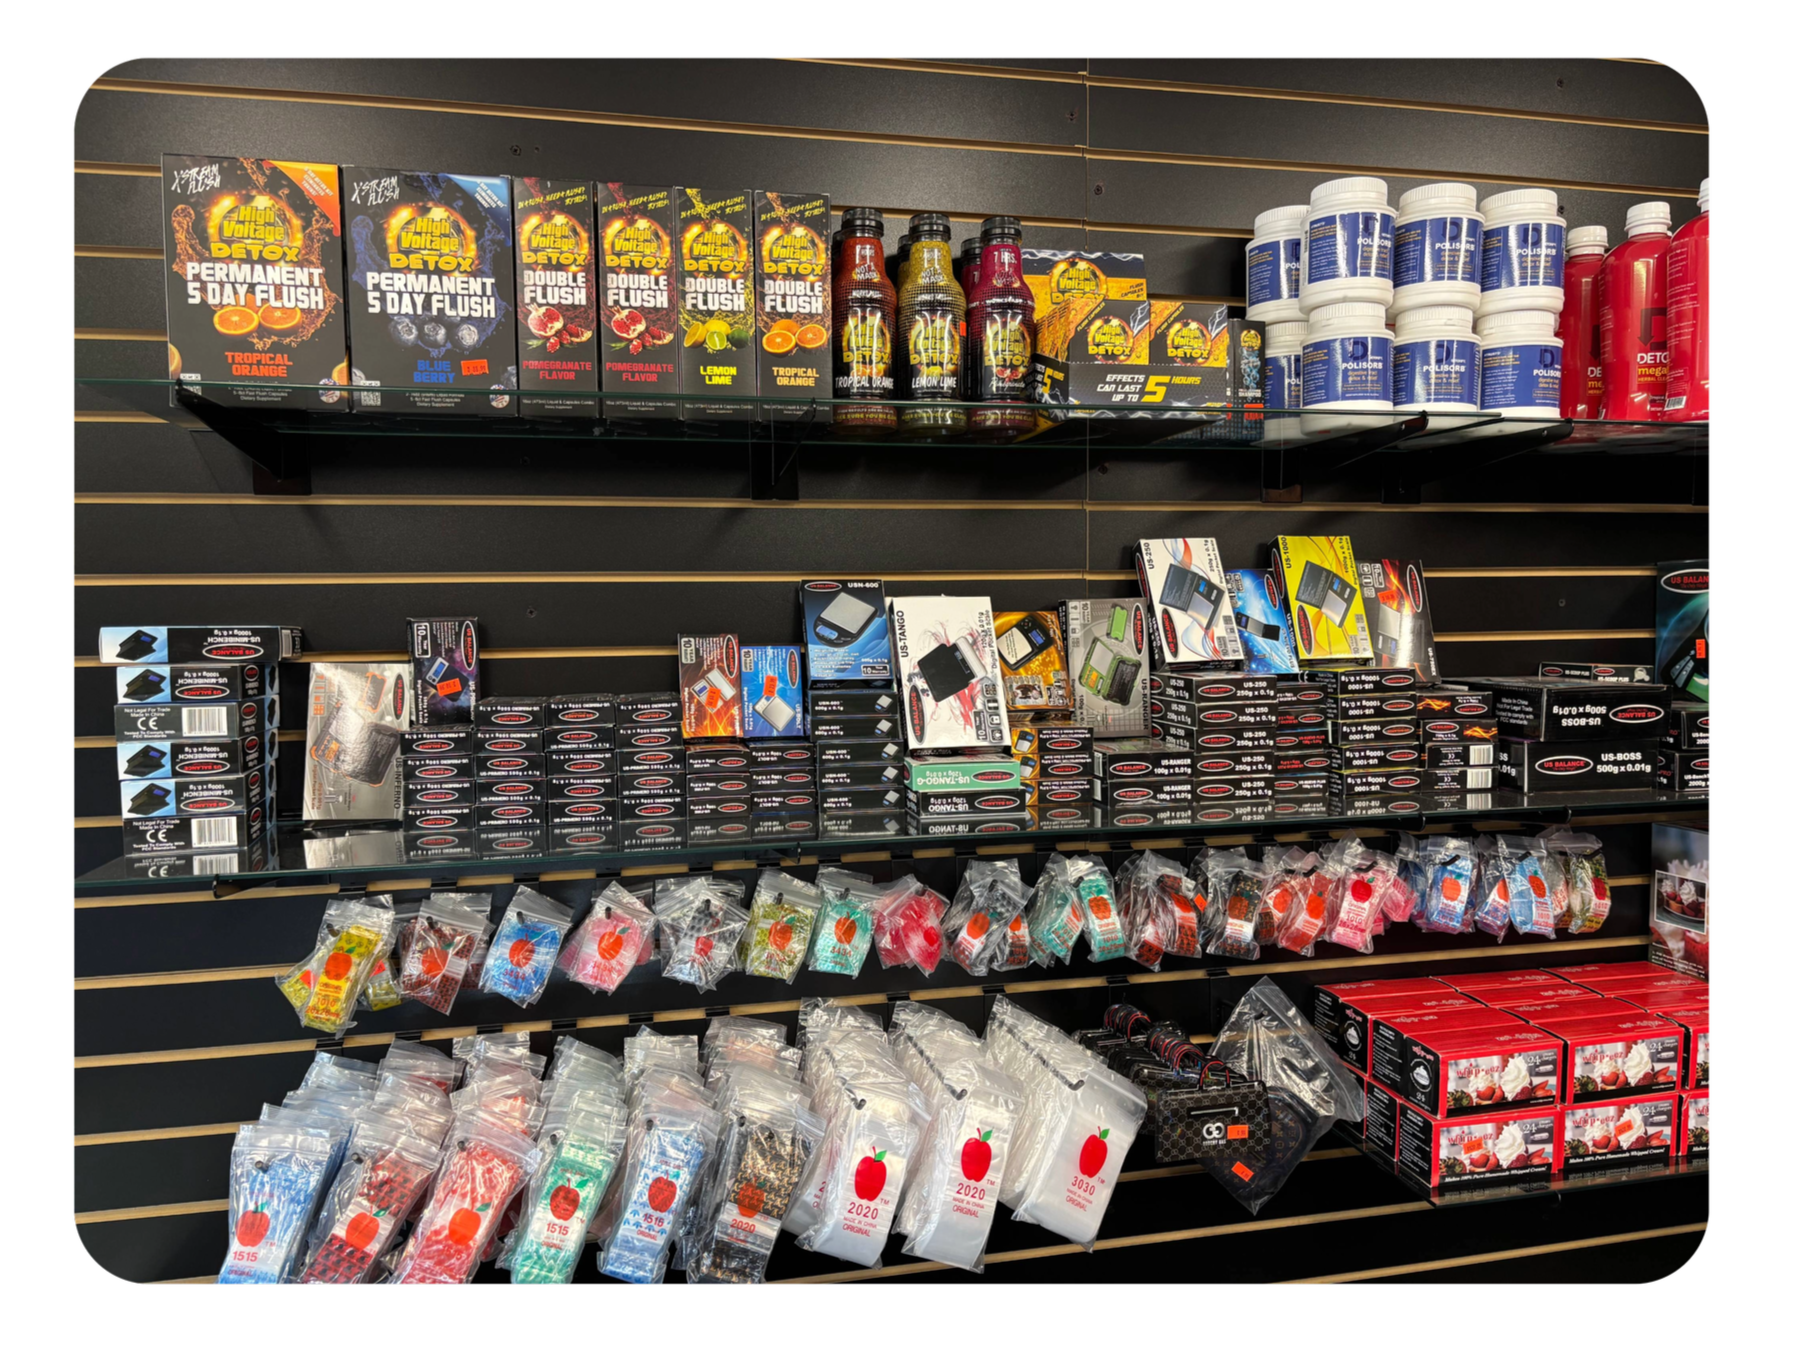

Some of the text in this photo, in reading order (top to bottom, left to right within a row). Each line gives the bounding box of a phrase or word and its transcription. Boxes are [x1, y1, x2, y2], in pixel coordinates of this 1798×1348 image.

[238, 206, 275, 222] High
[223, 220, 285, 241] Voltage
[415, 217, 450, 234] High
[542, 222, 569, 238] High
[626, 227, 651, 241] High
[705, 231, 729, 244] High
[401, 232, 459, 252] Voltage
[531, 234, 576, 249] Voltage
[615, 238, 658, 253] Voltage
[783, 234, 807, 248] High
[1435, 242, 1475, 251] POLISORB
[211, 242, 299, 261] DETOX
[693, 242, 735, 256] Voltage
[773, 246, 813, 260] Voltage
[1516, 248, 1556, 256] POLISORB
[389, 254, 473, 272] DETOX
[522, 252, 586, 265] DETOX
[606, 255, 668, 269] DETOX
[684, 260, 745, 273] DETOX
[764, 262, 823, 275] DETOX
[187, 262, 323, 286] PERMANENT
[524, 271, 586, 287] DOUBLE
[1069, 269, 1090, 279] High
[366, 272, 495, 296] PERMANENT
[607, 273, 667, 290] DOUBLE
[686, 277, 744, 294] DOUBLE
[765, 280, 822, 296] DOUBLE
[1059, 278, 1096, 291] Voltage
[188, 282, 324, 310] 5 DAY FLUSH
[524, 286, 586, 305] FLUSH
[607, 289, 668, 308] FLUSH
[368, 292, 495, 318] 5 DAY FLUSH
[686, 293, 745, 312] FLUSH
[765, 295, 822, 314] FLUSH
[1103, 324, 1120, 335] High
[1182, 327, 1199, 337] High
[1095, 332, 1125, 344] Voltage
[1174, 335, 1204, 347] Voltage
[1088, 345, 1131, 355] DETOX
[1167, 348, 1209, 358] DETOX
[225, 352, 293, 366] TROPICAL
[843, 352, 889, 363] DETOX
[910, 354, 957, 365] DETOX
[984, 355, 1028, 366] DETOX
[232, 365, 287, 377] ORANGE
[417, 360, 451, 372] BLUE
[523, 361, 592, 371] POMEGRANATE
[606, 363, 673, 372] POMEGRANATE
[700, 366, 736, 376] LEMON
[773, 367, 819, 377] TROPICAL
[1342, 362, 1383, 370] POLISORB
[1423, 364, 1465, 372] POLISORB
[414, 371, 455, 383] BERRY
[540, 371, 575, 380] FLAVOR
[622, 372, 658, 382] FLAVOR
[706, 376, 732, 385] LIME
[777, 376, 815, 386] ORANGE
[912, 376, 957, 388] LEMON LIME
[1106, 374, 1145, 383] EFFECTS
[836, 376, 894, 389] TROPICAL ORANGE
[1097, 384, 1142, 393] CAN LAST
[1141, 376, 1171, 402] 5
[1126, 394, 1139, 402] TO
[1144, 542, 1155, 570] US-250
[1281, 537, 1292, 568] US-1000
[1682, 576, 1709, 584] BALAN
[417, 625, 427, 635] 10
[895, 610, 909, 658] US-TANGO
[1135, 622, 1143, 650] BALANCE
[909, 691, 924, 721] BALANCE
[1140, 678, 1149, 730] US-RANGER
[1552, 705, 1577, 715] 0.01g
[1585, 706, 1607, 715] 500g
[1238, 714, 1276, 723] 250g 0.1g
[1561, 718, 1601, 726] US-BOSS
[1261, 738, 1274, 746] 0.1g
[1601, 752, 1642, 761] US-BOSS
[1555, 760, 1586, 768] BALANCE
[1597, 764, 1618, 774] 500g
[1627, 763, 1651, 773] 0.01g
[1154, 767, 1172, 775] 100g
[917, 777, 970, 785] US-TANGO-G
[928, 804, 969, 812] US-TANGO
[831, 946, 852, 957] 3434
[1650, 1042, 1663, 1052] 24
[1527, 1056, 1541, 1066] 24
[1642, 1106, 1656, 1116] 24
[1522, 1123, 1537, 1134] 24
[955, 1183, 986, 1200] 2020
[1071, 1175, 1096, 1196] 3030
[880, 1198, 890, 1206] TM
[952, 1197, 985, 1210] MADE CHINA
[1065, 1195, 1088, 1212] ORIGINAL
[847, 1202, 879, 1220] 2020
[952, 1204, 979, 1218] ORIGINAL
[643, 1213, 664, 1227] 1515
[730, 1218, 756, 1233] 2020
[843, 1216, 857, 1225] MADE
[864, 1221, 878, 1229] CHINA
[546, 1222, 569, 1236] 1515
[842, 1223, 871, 1238] ORIGINAL
[233, 1251, 258, 1262] 1515
